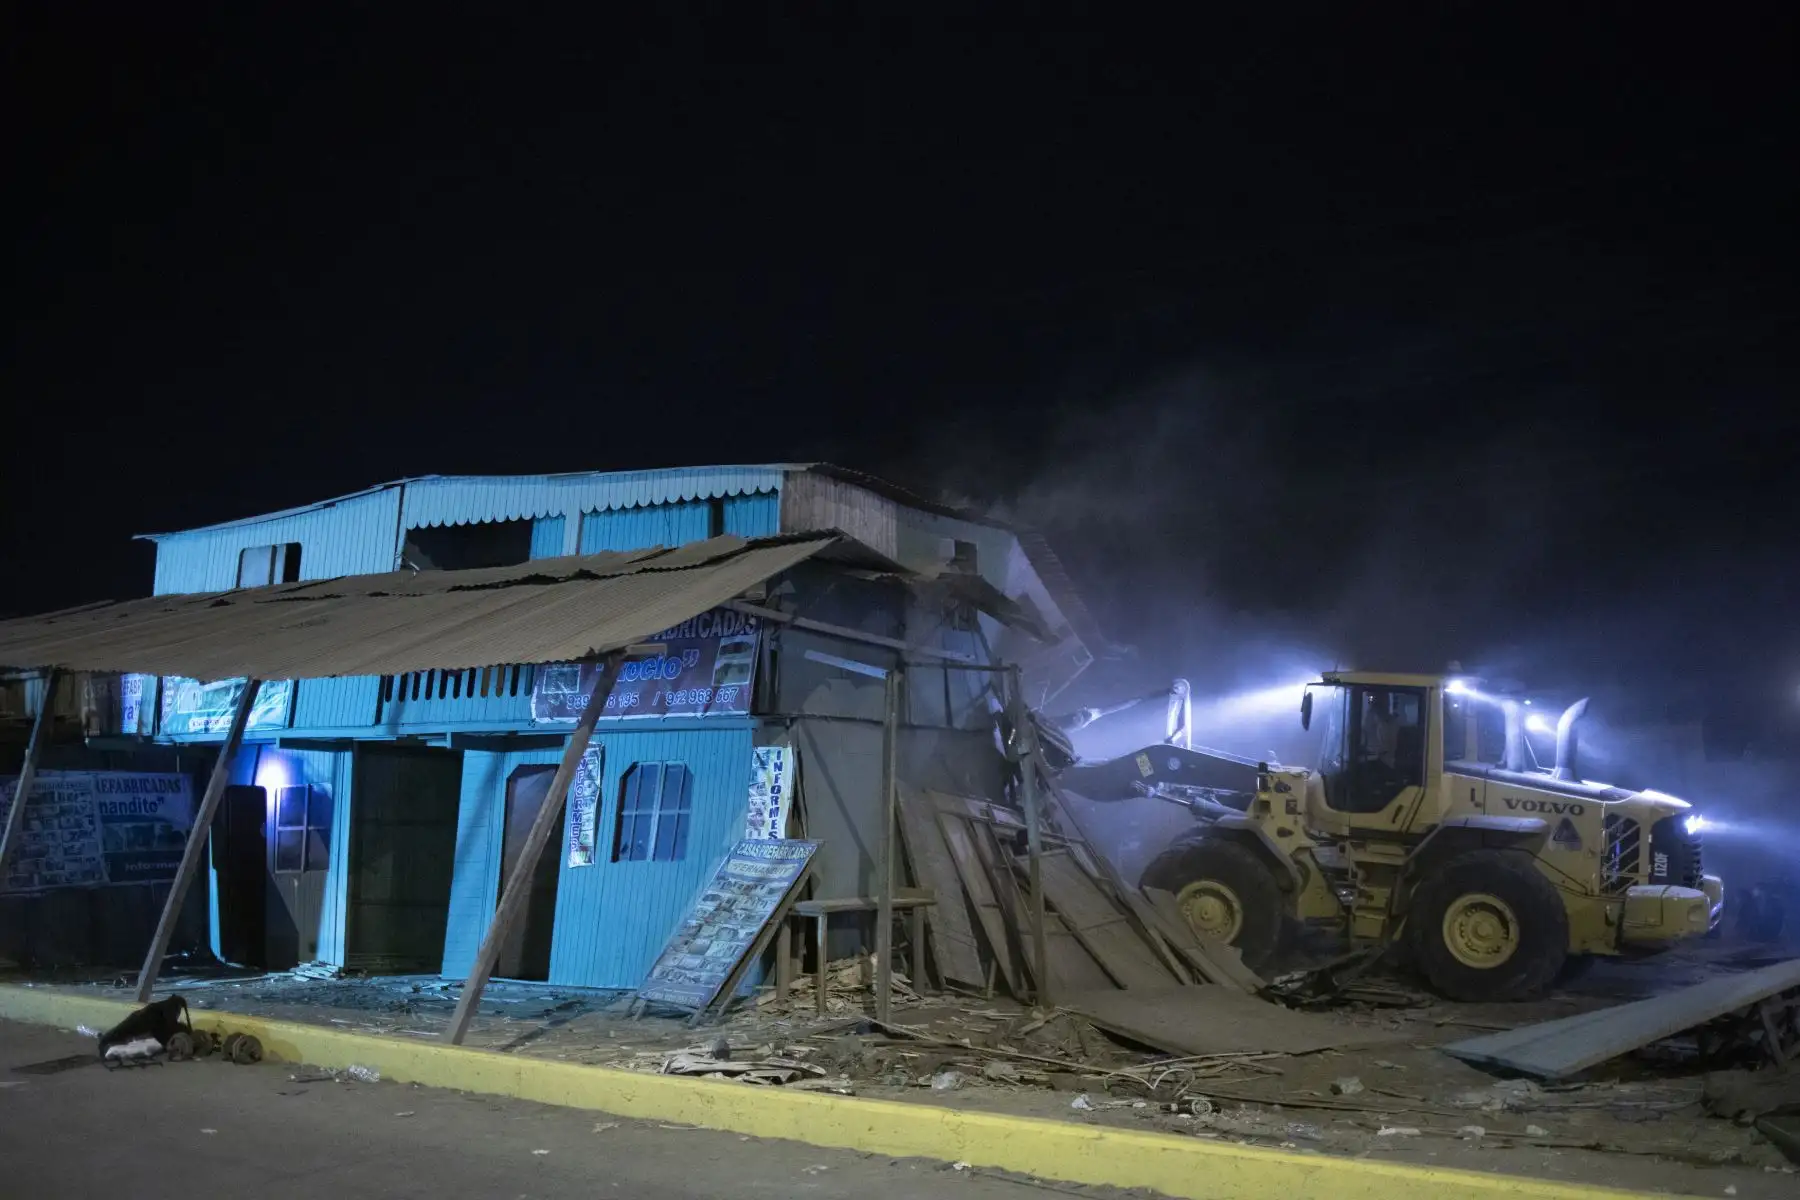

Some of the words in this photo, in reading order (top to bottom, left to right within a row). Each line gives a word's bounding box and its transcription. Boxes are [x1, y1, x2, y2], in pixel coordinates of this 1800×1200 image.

[655, 610, 757, 641] BRICADAS
[570, 756, 589, 853] NFORMES
[768, 750, 783, 840] INFORMES
[1502, 798, 1585, 816] VOLVO
